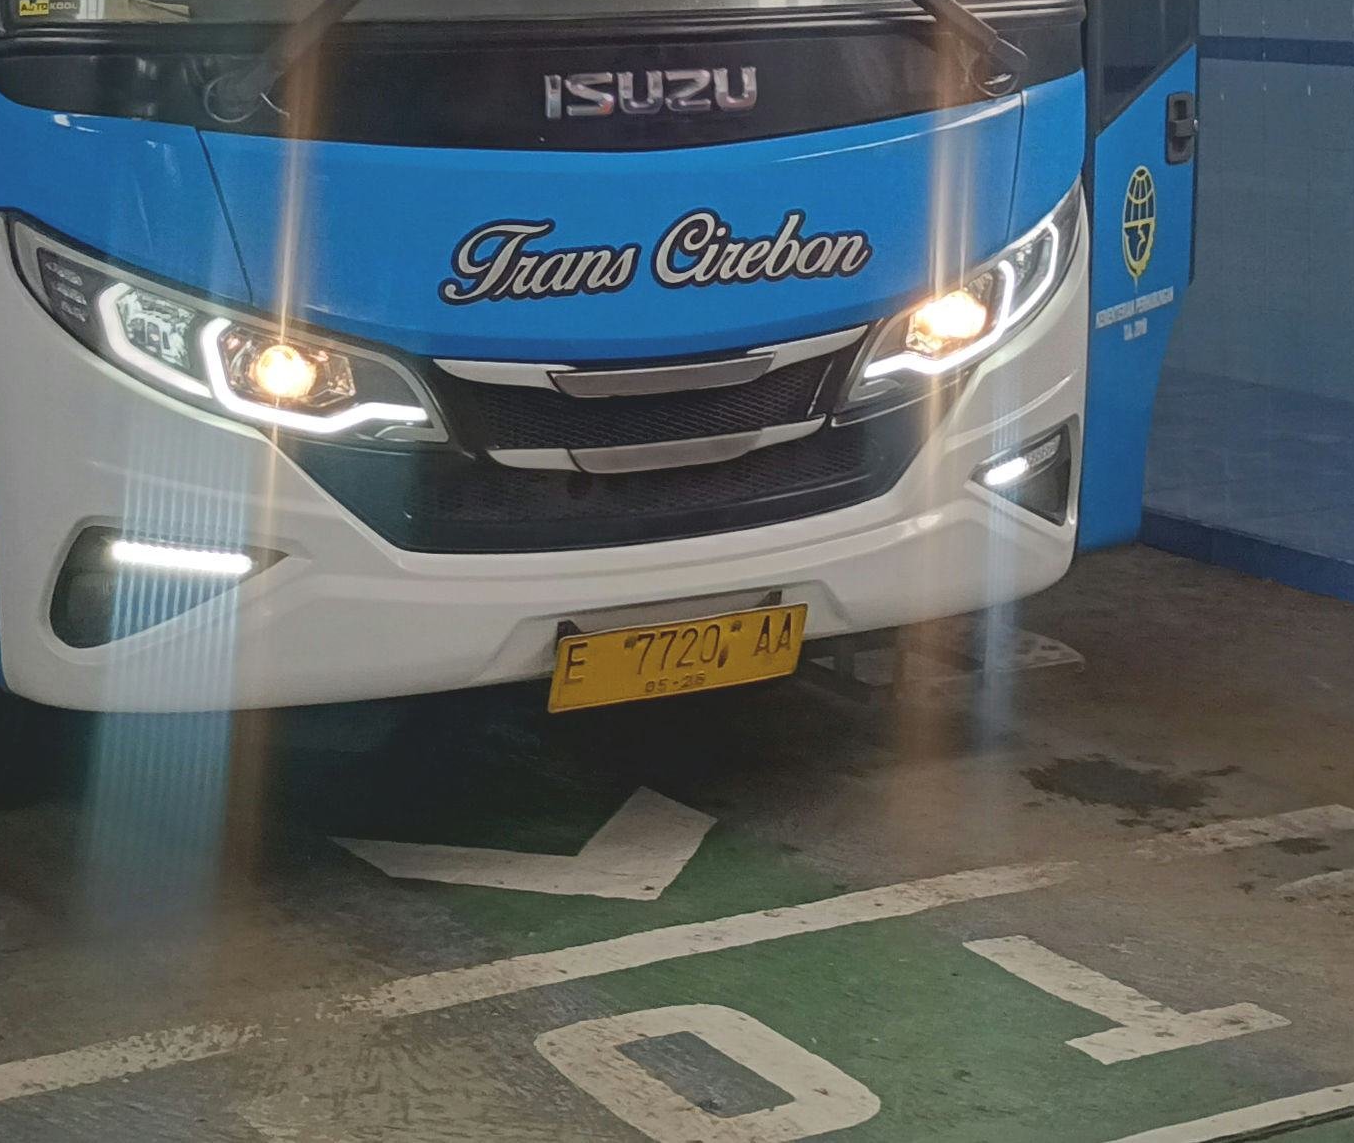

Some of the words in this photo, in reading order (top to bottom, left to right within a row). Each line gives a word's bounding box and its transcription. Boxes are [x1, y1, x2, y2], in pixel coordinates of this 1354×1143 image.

[545, 66, 757, 120] ISUZU
[442, 220, 638, 302] Trans
[654, 211, 872, 286] Cirebon
[564, 642, 588, 685] E
[636, 623, 721, 675] 7720
[753, 612, 792, 657] AA
